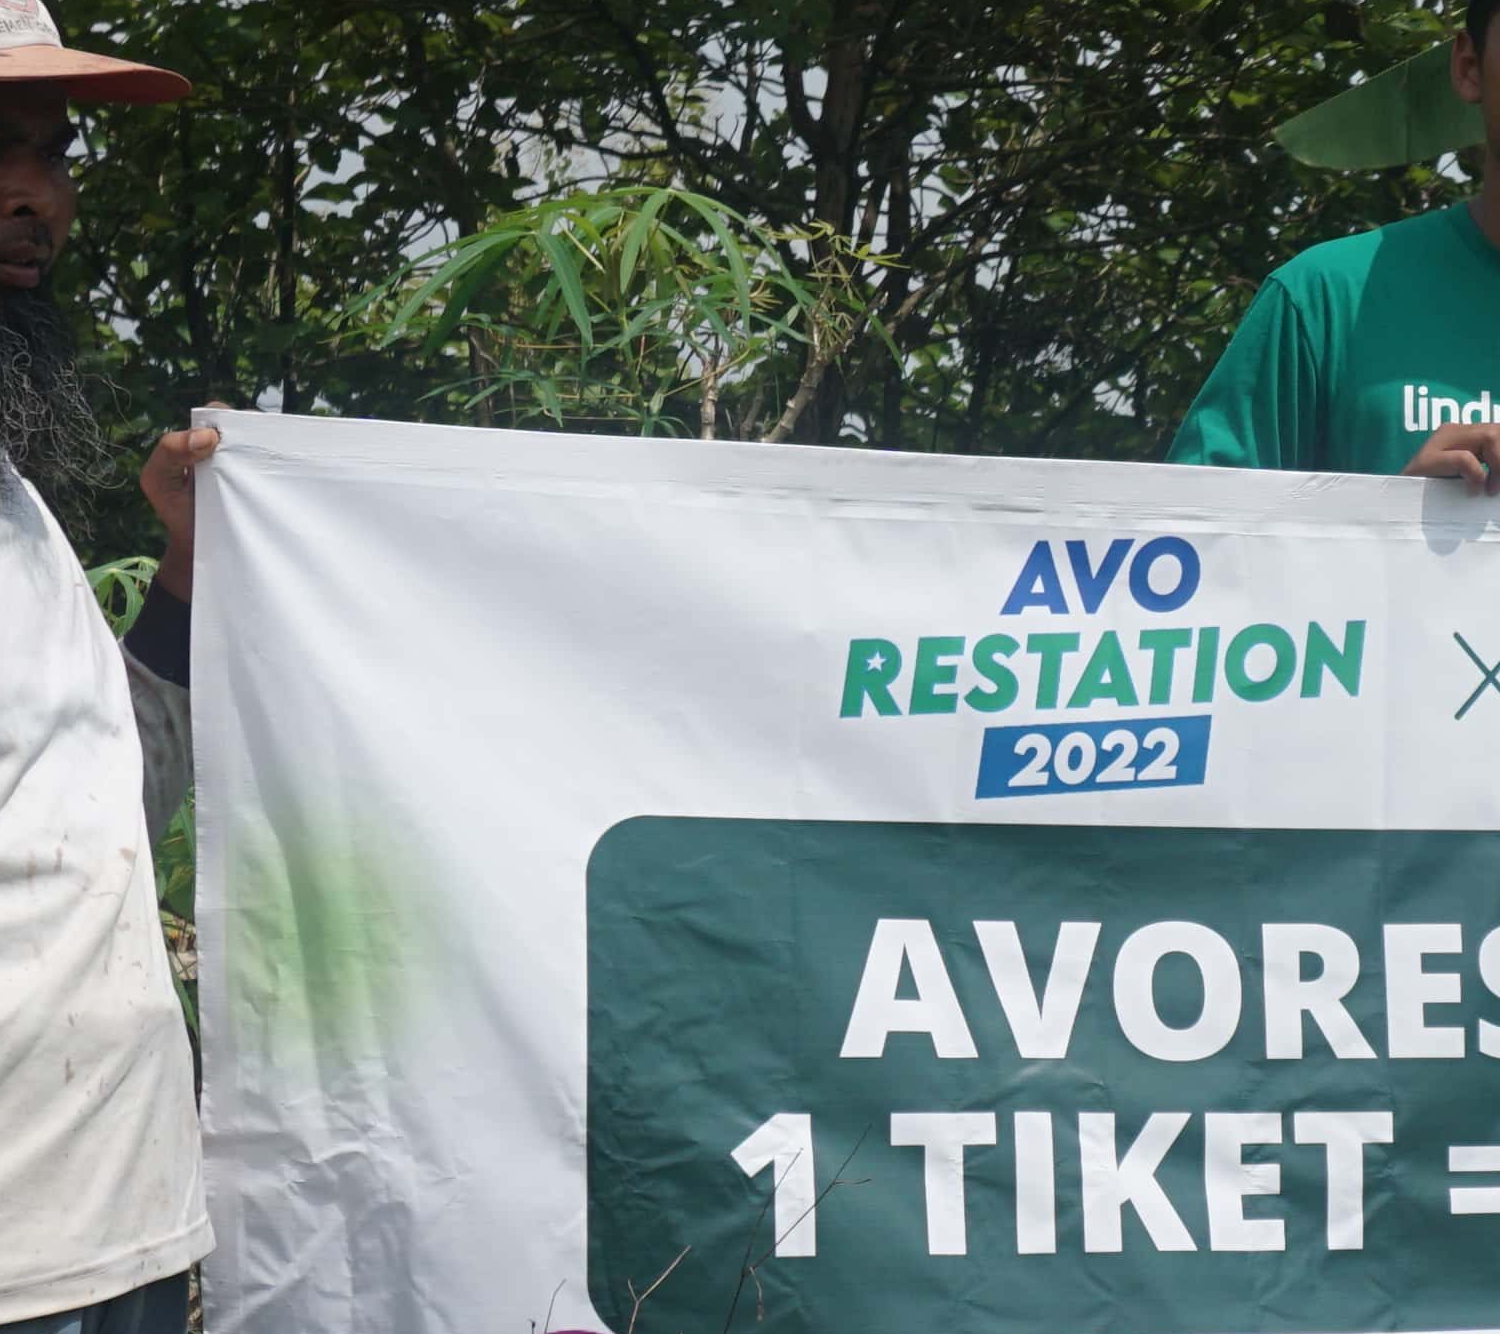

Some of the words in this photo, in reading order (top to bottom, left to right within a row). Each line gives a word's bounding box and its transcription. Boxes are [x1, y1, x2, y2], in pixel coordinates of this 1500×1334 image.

[1000, 536, 1200, 615] AVO
[839, 620, 1366, 718] RESTATION
[1007, 727, 1180, 787] 2022
[729, 1113, 816, 1257] 1
[890, 1111, 1393, 1256] TIKET
